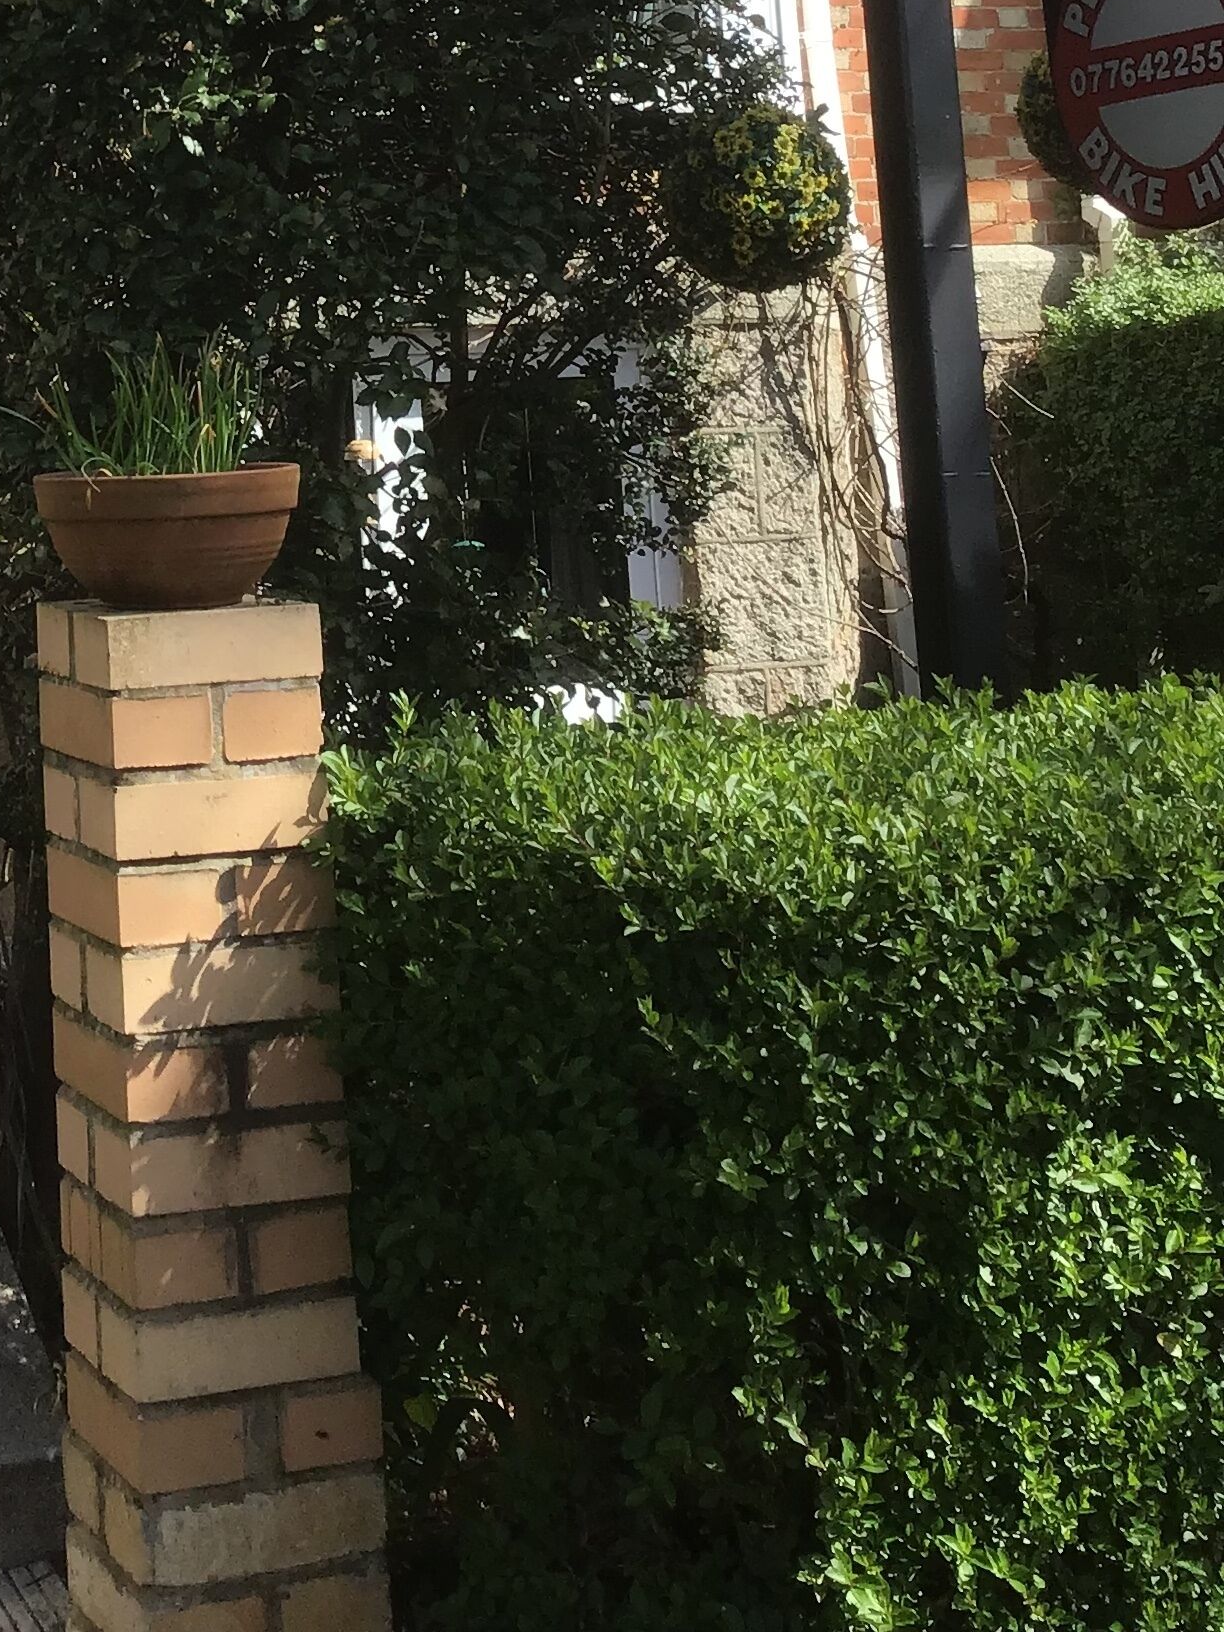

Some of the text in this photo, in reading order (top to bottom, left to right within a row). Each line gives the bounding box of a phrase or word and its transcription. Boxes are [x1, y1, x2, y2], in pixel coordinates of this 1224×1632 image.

[1069, 39, 1224, 98] 077642255
[1078, 126, 1224, 216] BIKE HI
